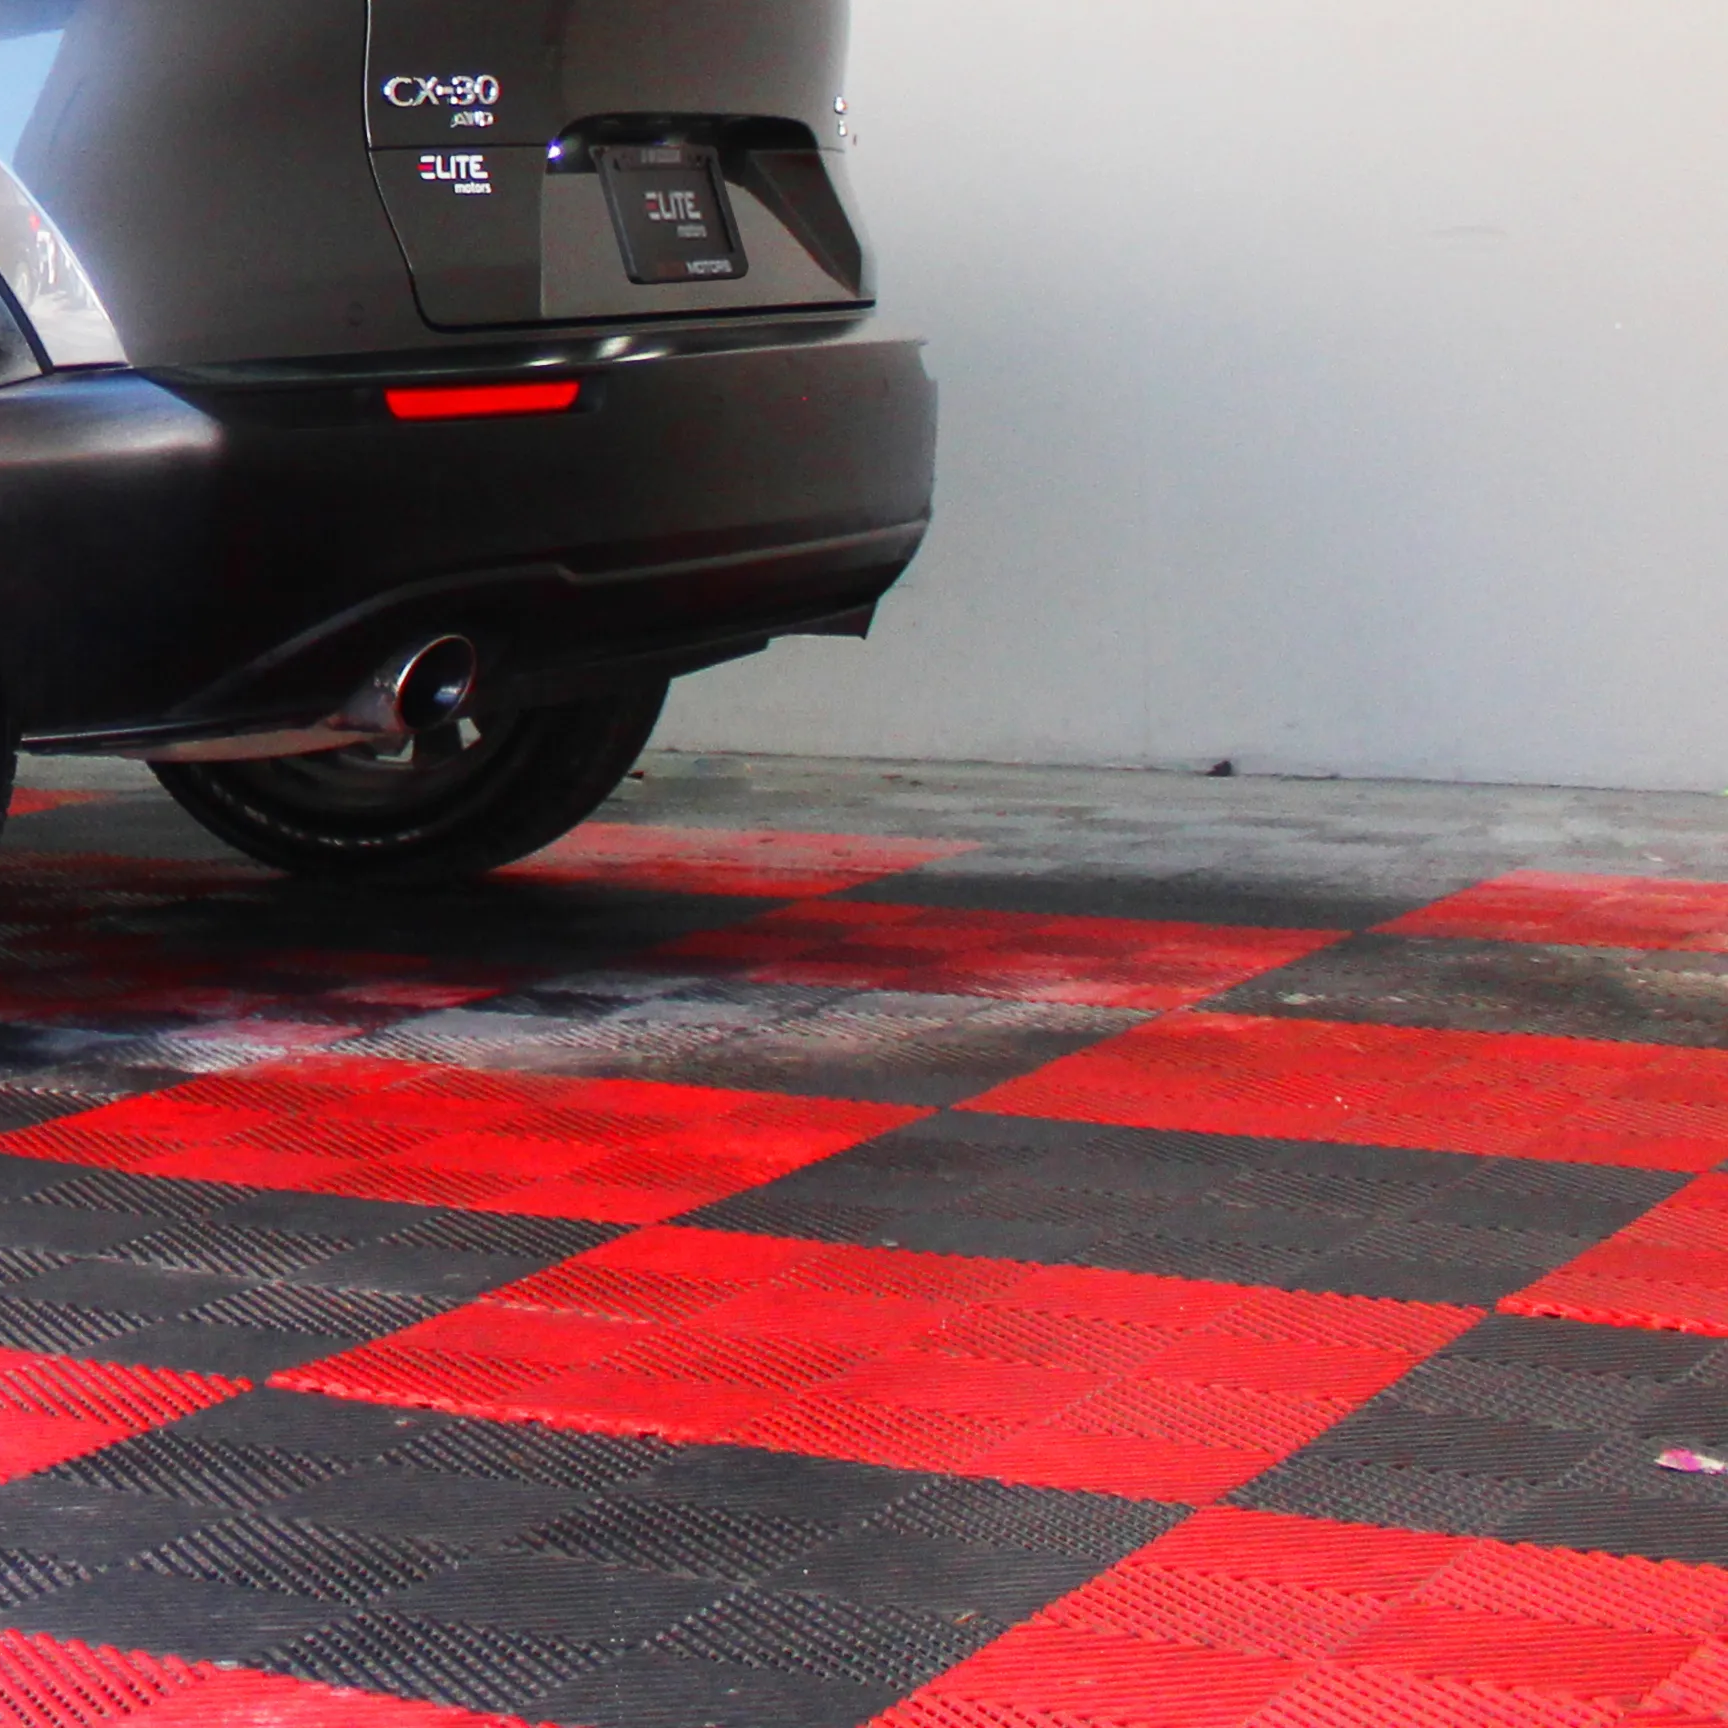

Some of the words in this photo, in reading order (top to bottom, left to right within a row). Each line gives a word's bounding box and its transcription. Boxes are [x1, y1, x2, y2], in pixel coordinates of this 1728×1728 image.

[383, 74, 500, 107] CX-30
[417, 155, 489, 180] ELITE
[454, 181, 492, 194] motors
[645, 190, 702, 221] ELITE
